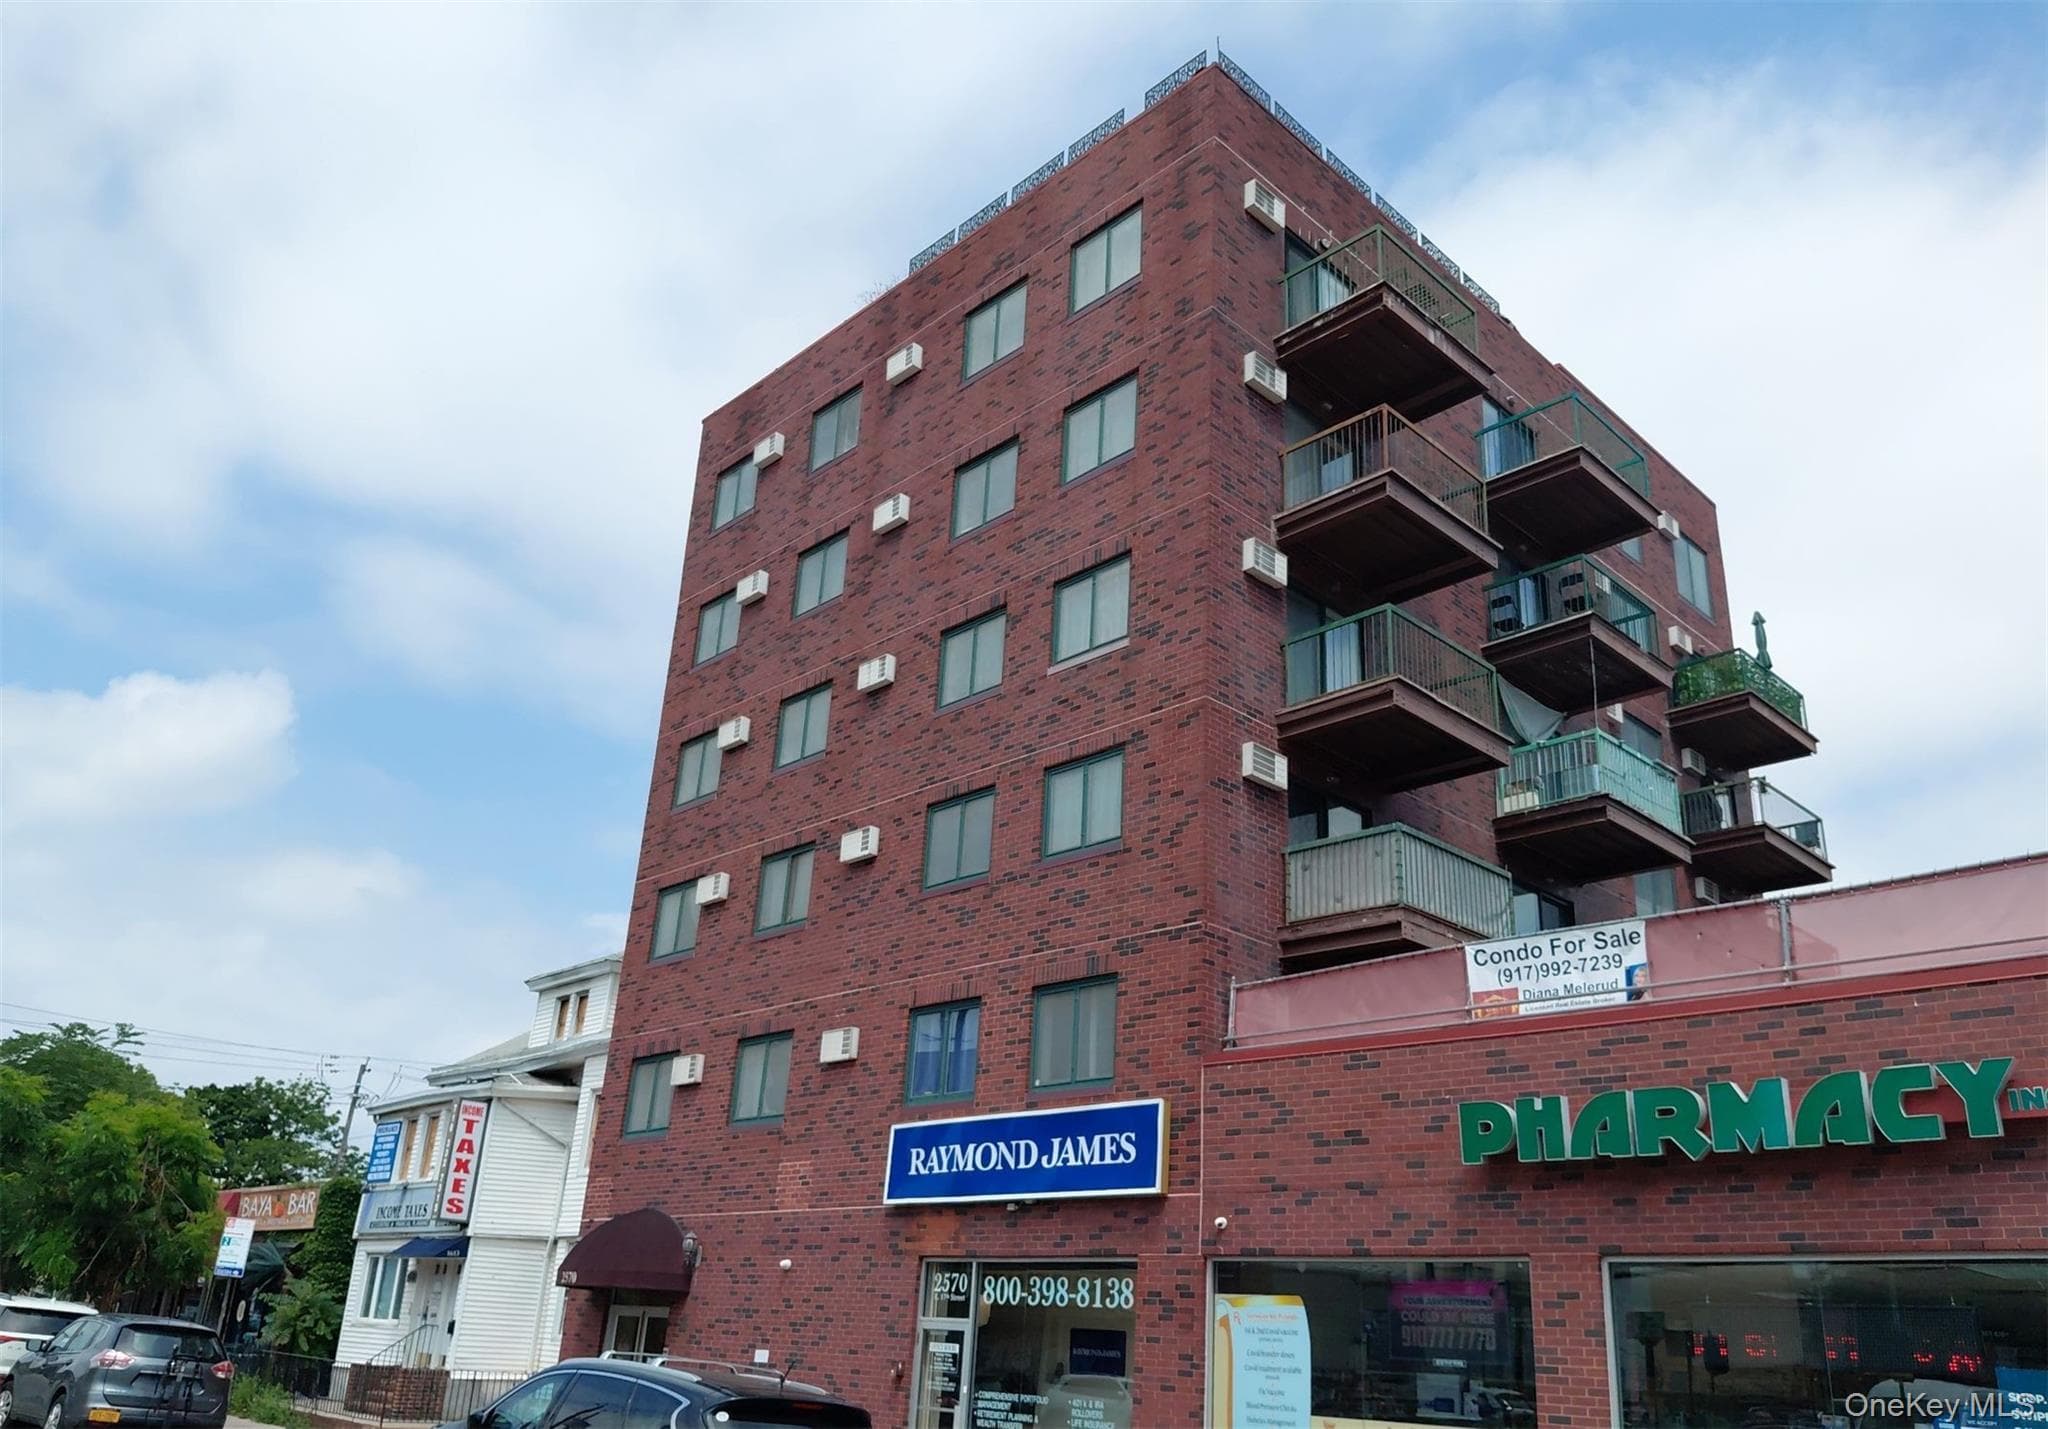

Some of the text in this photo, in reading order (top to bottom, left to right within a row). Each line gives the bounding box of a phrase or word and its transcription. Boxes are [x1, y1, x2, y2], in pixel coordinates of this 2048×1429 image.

[1473, 928, 1642, 967] Condo For Sale
[1497, 952, 1624, 987] (917)992-7239
[1522, 988, 1560, 1001] Diana
[1457, 1056, 2048, 1166] PHARMACY IN
[446, 1118, 480, 1214] TAXES
[907, 1131, 1137, 1176] RAYMOND JAMES
[241, 1191, 317, 1218] BAYA BAR
[376, 1203, 429, 1219] INCOME TAXES
[934, 1272, 968, 1293] 2570
[983, 1275, 1135, 1310] 800-398-8138
